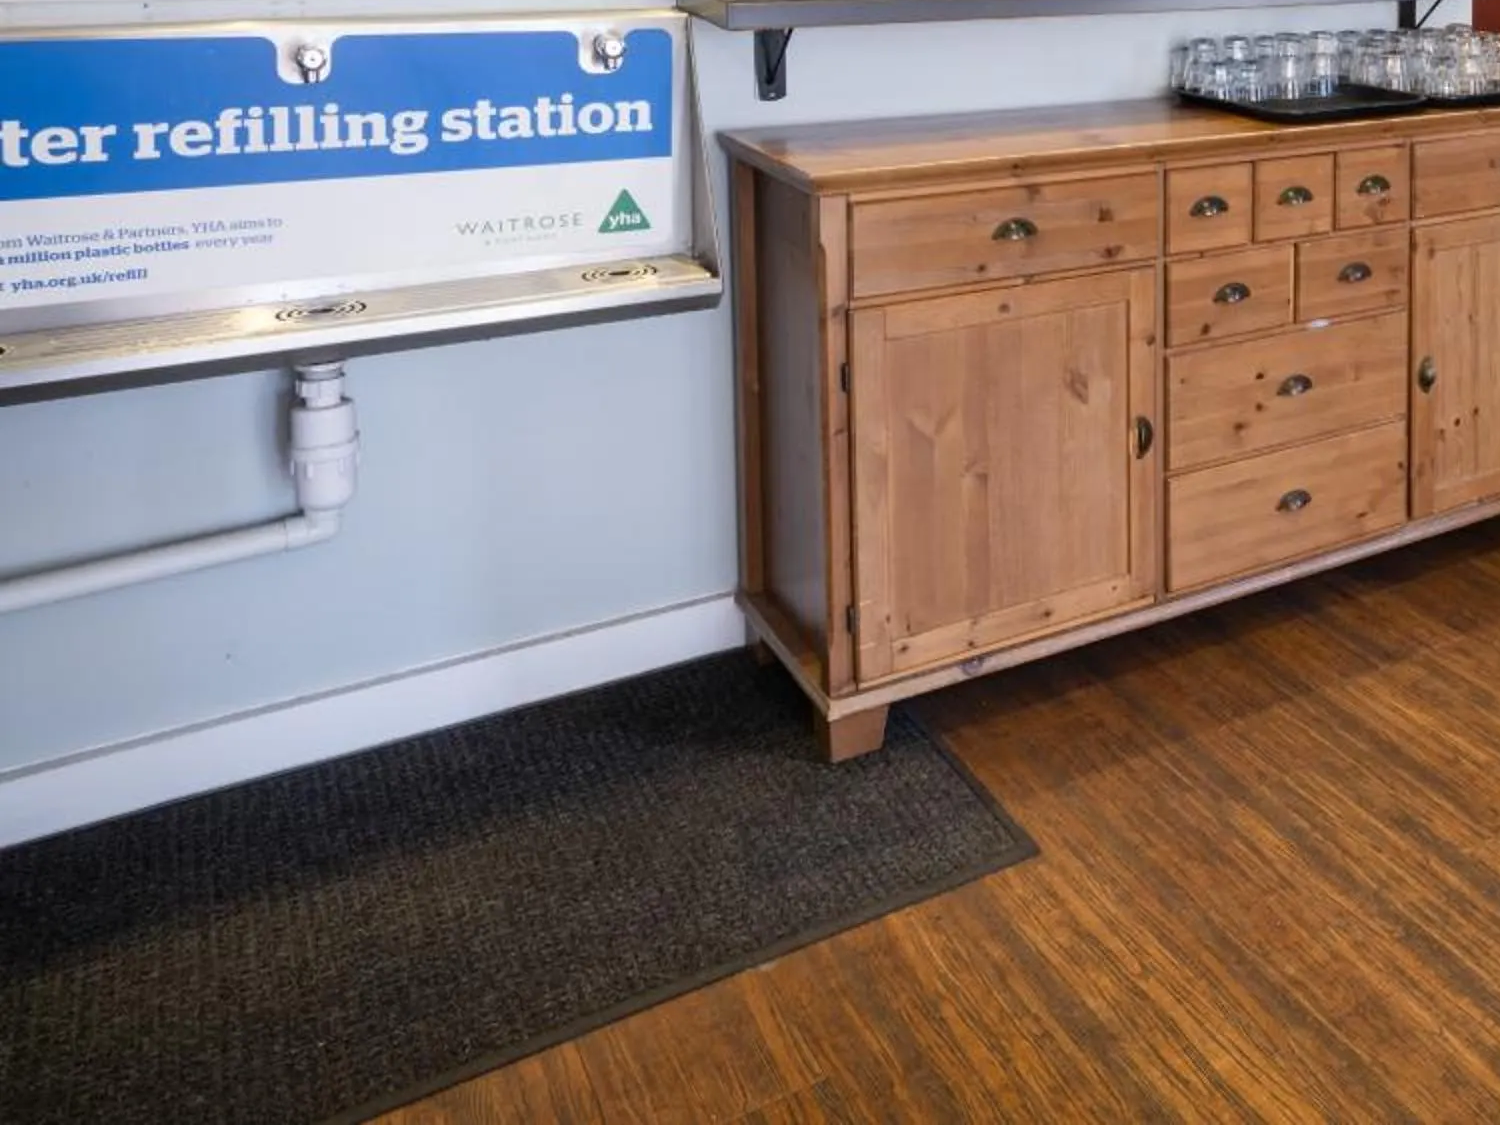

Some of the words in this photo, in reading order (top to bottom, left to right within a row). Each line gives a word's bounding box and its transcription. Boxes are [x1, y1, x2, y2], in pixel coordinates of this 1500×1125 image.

[0, 120, 116, 168] ter
[133, 103, 429, 159] refilling
[441, 92, 653, 142] station
[456, 211, 585, 236] WAITROSE
[609, 210, 641, 229] yha
[27, 231, 101, 247] Waitrose
[192, 221, 226, 233] YHA
[8, 249, 71, 265] million
[74, 244, 130, 261] plastic
[133, 240, 189, 253] bottles
[195, 236, 238, 249] every
[241, 233, 274, 246] year
